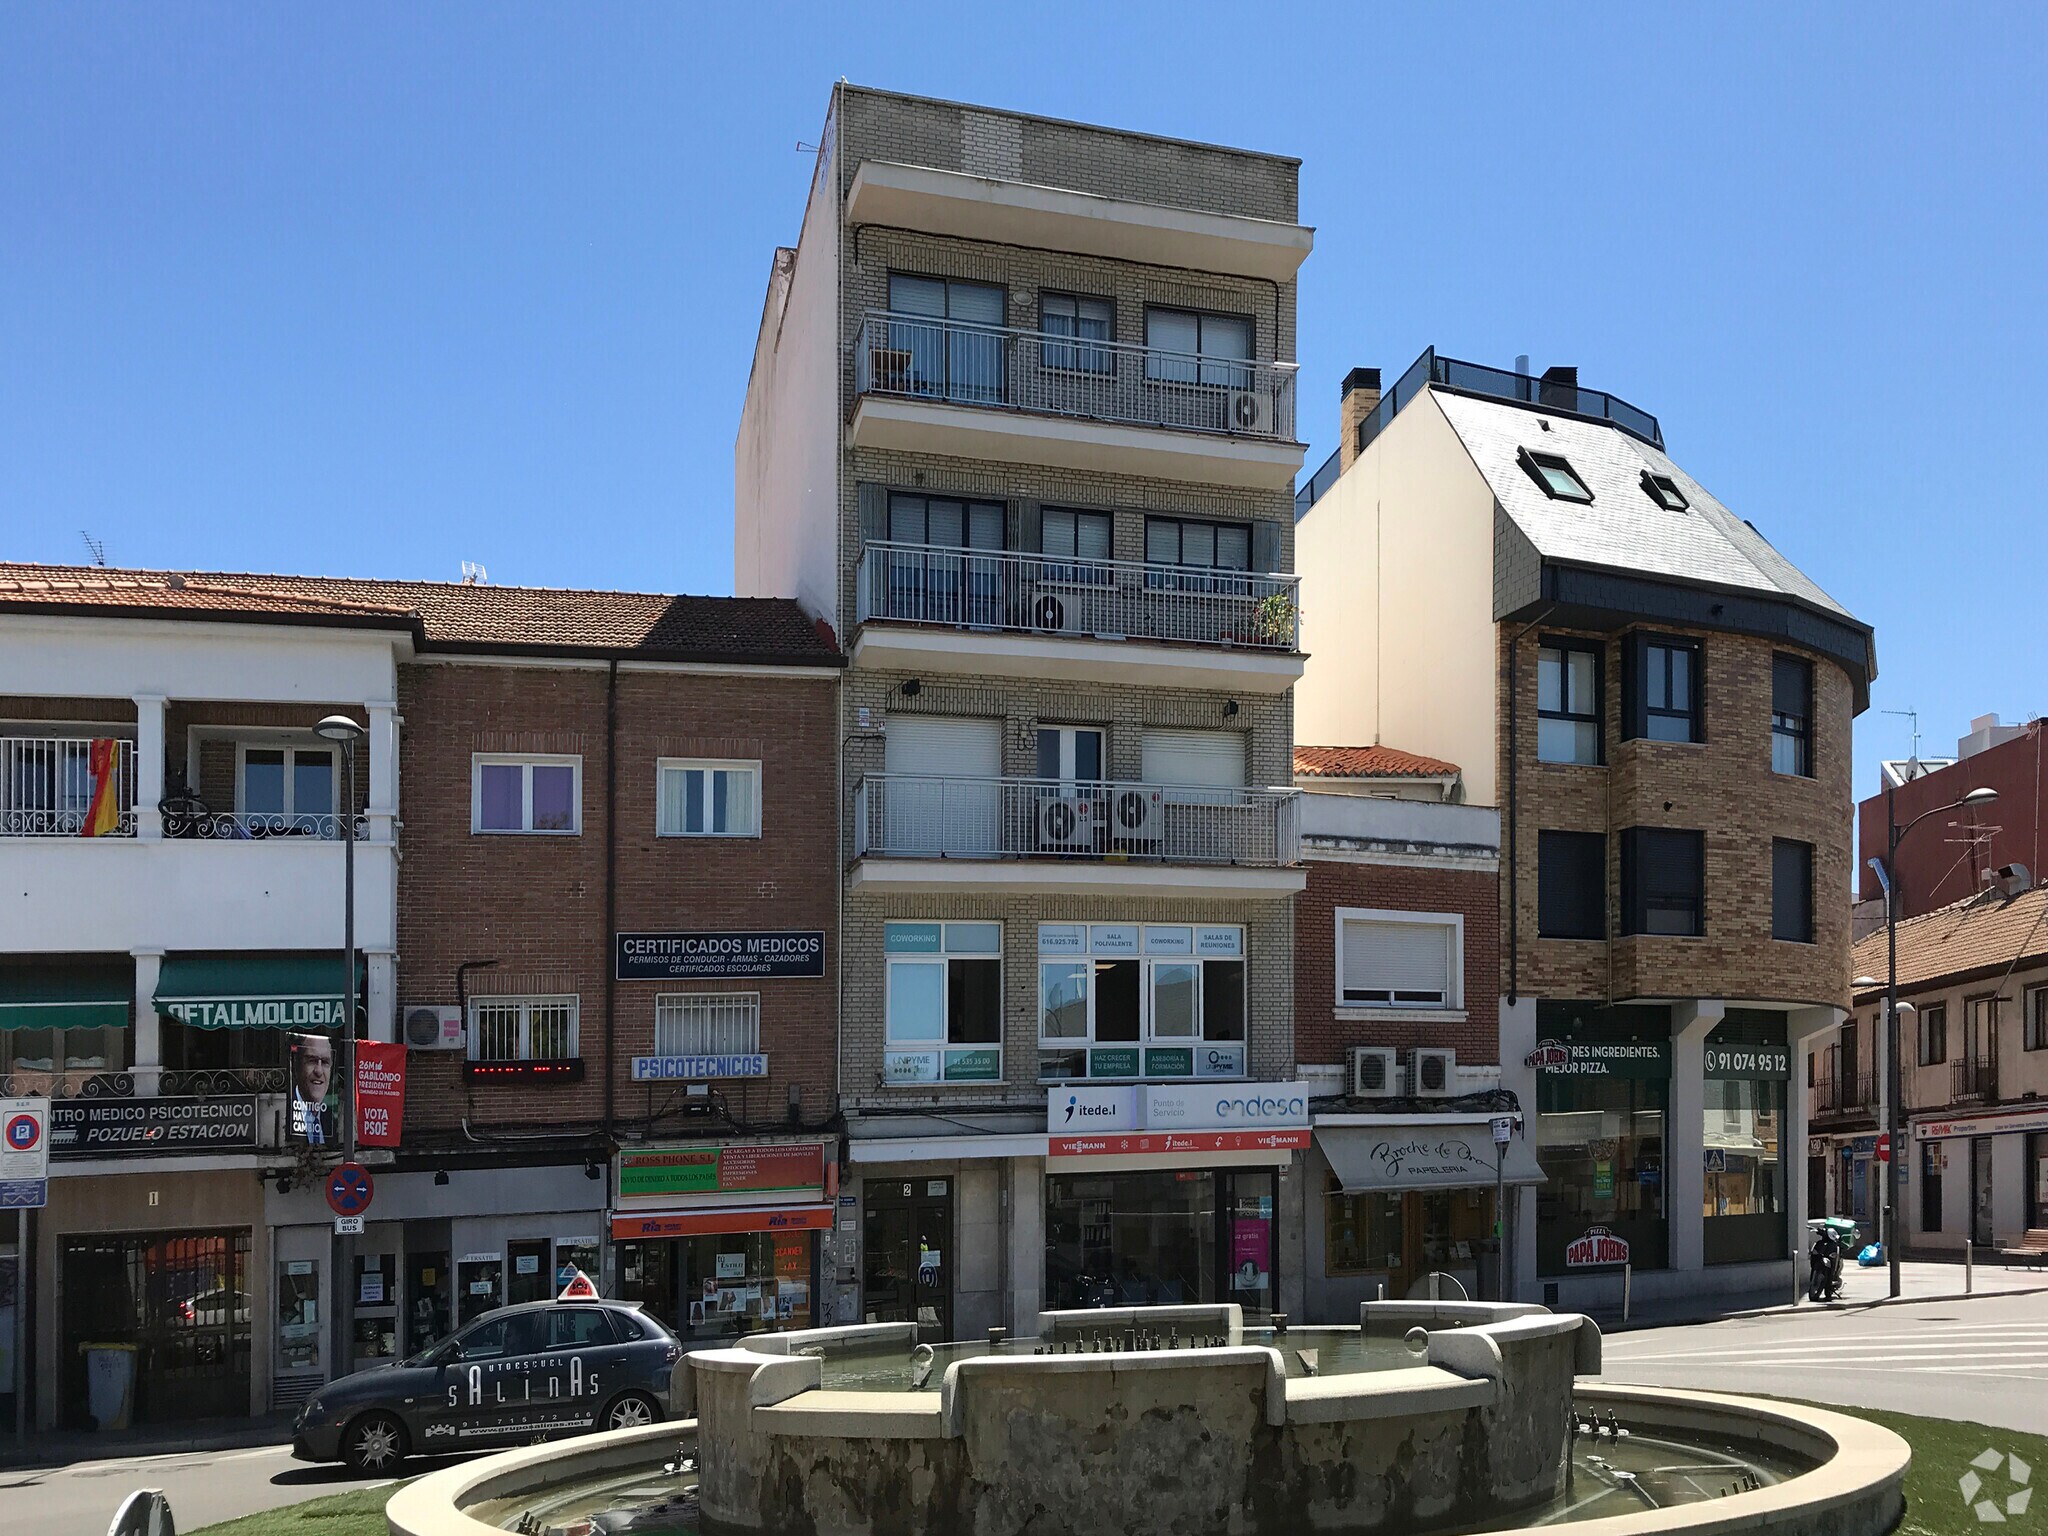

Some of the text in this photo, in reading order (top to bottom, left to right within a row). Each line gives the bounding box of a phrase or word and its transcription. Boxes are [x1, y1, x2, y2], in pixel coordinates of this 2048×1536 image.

[890, 934, 936, 942] COWORKING
[623, 938, 819, 954] CERTIFICADOS MEDICOS
[628, 955, 669, 964] PERMISOS
[671, 955, 682, 963] DE
[683, 955, 726, 963] CONDUCIR
[731, 954, 758, 963] ARMAS
[764, 954, 810, 962] CAZADORES
[669, 963, 772, 973] CERTIFICADOS ESCOLARES
[168, 1001, 345, 1025] OFTALMOLOGIA
[1592, 1046, 1660, 1058] INGREDIENTES.
[638, 1056, 762, 1079] PSICOTECNICOS
[1719, 1052, 1786, 1071] 91 074 95 12
[1545, 1062, 1610, 1074] MEJOR PIZZA.
[358, 1070, 401, 1082] GABILONDO
[358, 1080, 392, 1090] PRESIDENTE
[293, 1100, 327, 1112] CONTIGO
[1153, 1099, 1185, 1107] Punto de
[1216, 1095, 1304, 1118] endesa
[50, 1103, 253, 1122] NTRO MEDICO PSICOTECNICO
[293, 1111, 307, 1122] HAY
[364, 1107, 389, 1120] VOTA
[1153, 1108, 1185, 1116] Servicio
[87, 1123, 249, 1142] POZUELO ESTACION
[293, 1121, 321, 1133] CAMBIO
[364, 1120, 388, 1136] PSOE
[636, 1156, 661, 1164] ROSS
[663, 1154, 696, 1164] PHONE
[1408, 1165, 1468, 1175] PAPELERIA
[904, 1184, 910, 1195] 2
[769, 1213, 788, 1225] Ria
[642, 1219, 661, 1232] Ria
[775, 1247, 803, 1256] SCANNER
[1568, 1240, 1594, 1263] PAPA
[469, 1420, 584, 1434] www.gruposalinas.net
